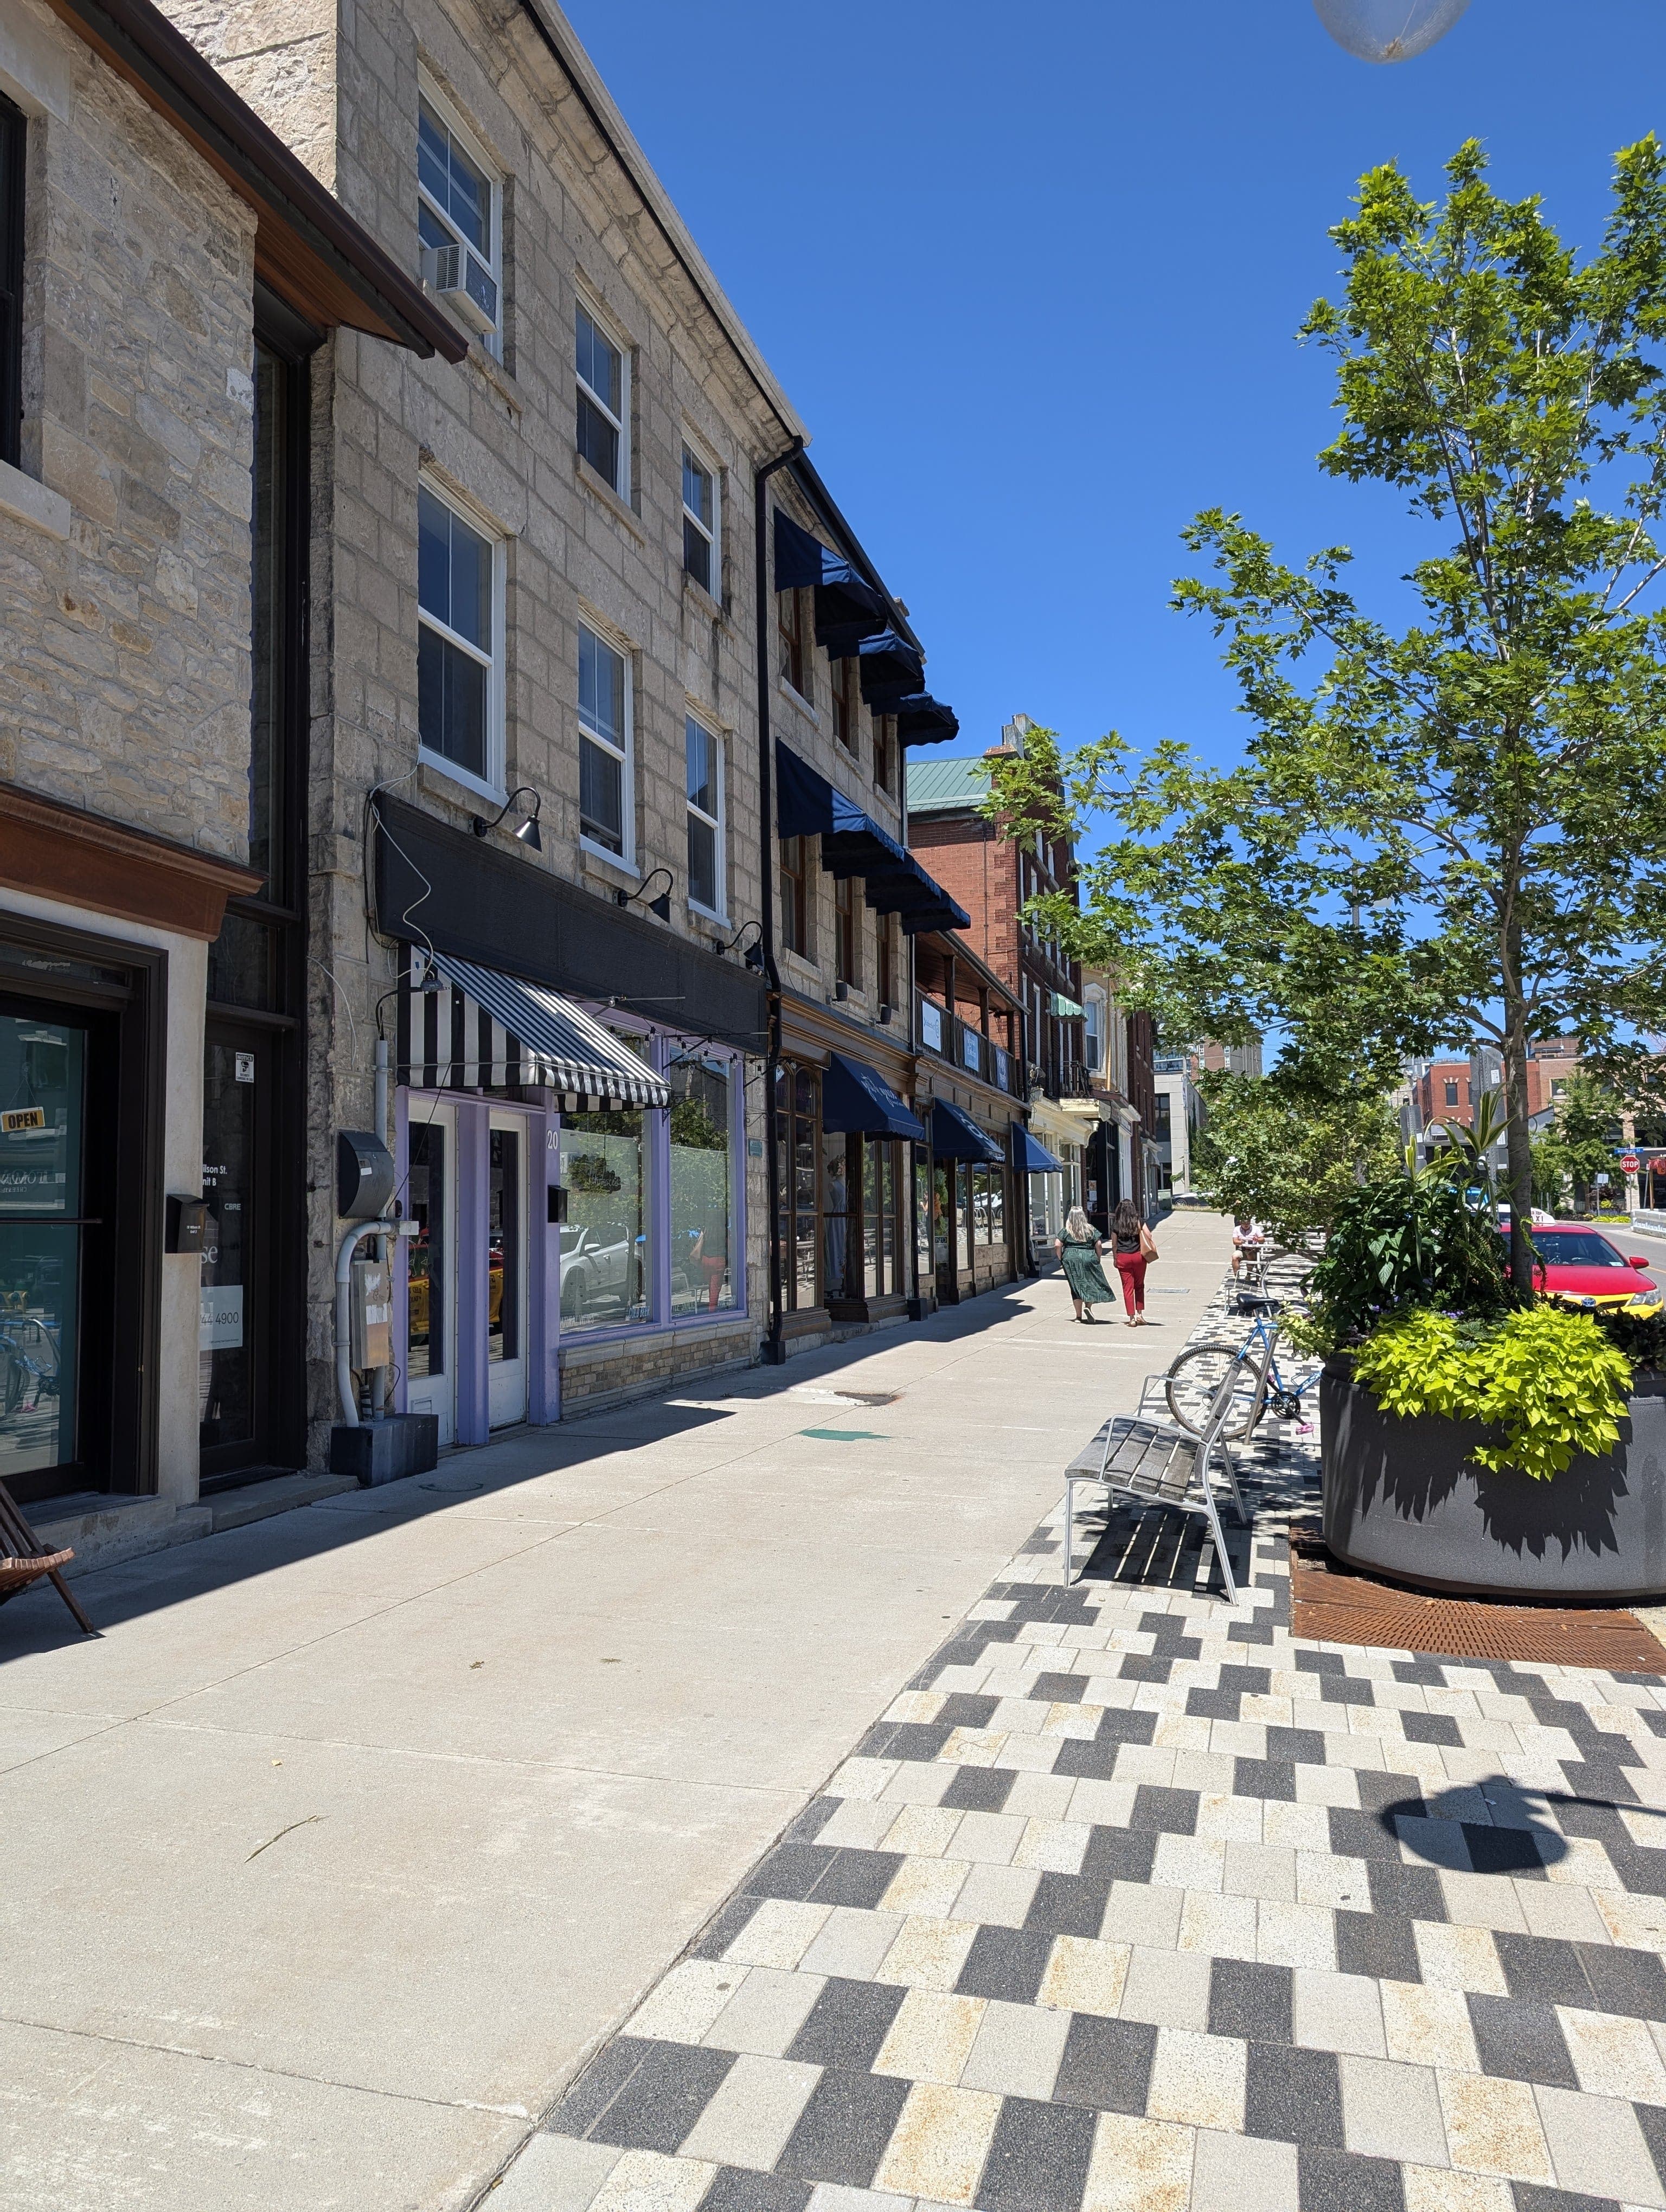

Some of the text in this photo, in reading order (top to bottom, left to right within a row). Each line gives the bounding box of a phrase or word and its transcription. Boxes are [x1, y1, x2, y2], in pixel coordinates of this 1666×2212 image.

[8, 1112, 38, 1129] OPEN
[547, 1129, 558, 1150] 20
[203, 1164, 228, 1174] ilson St.
[202, 1177, 216, 1186] nit B
[201, 1246, 218, 1264] se
[200, 1311, 239, 1326] 44 4900
[629, 1305, 651, 1319] COLD BEER
